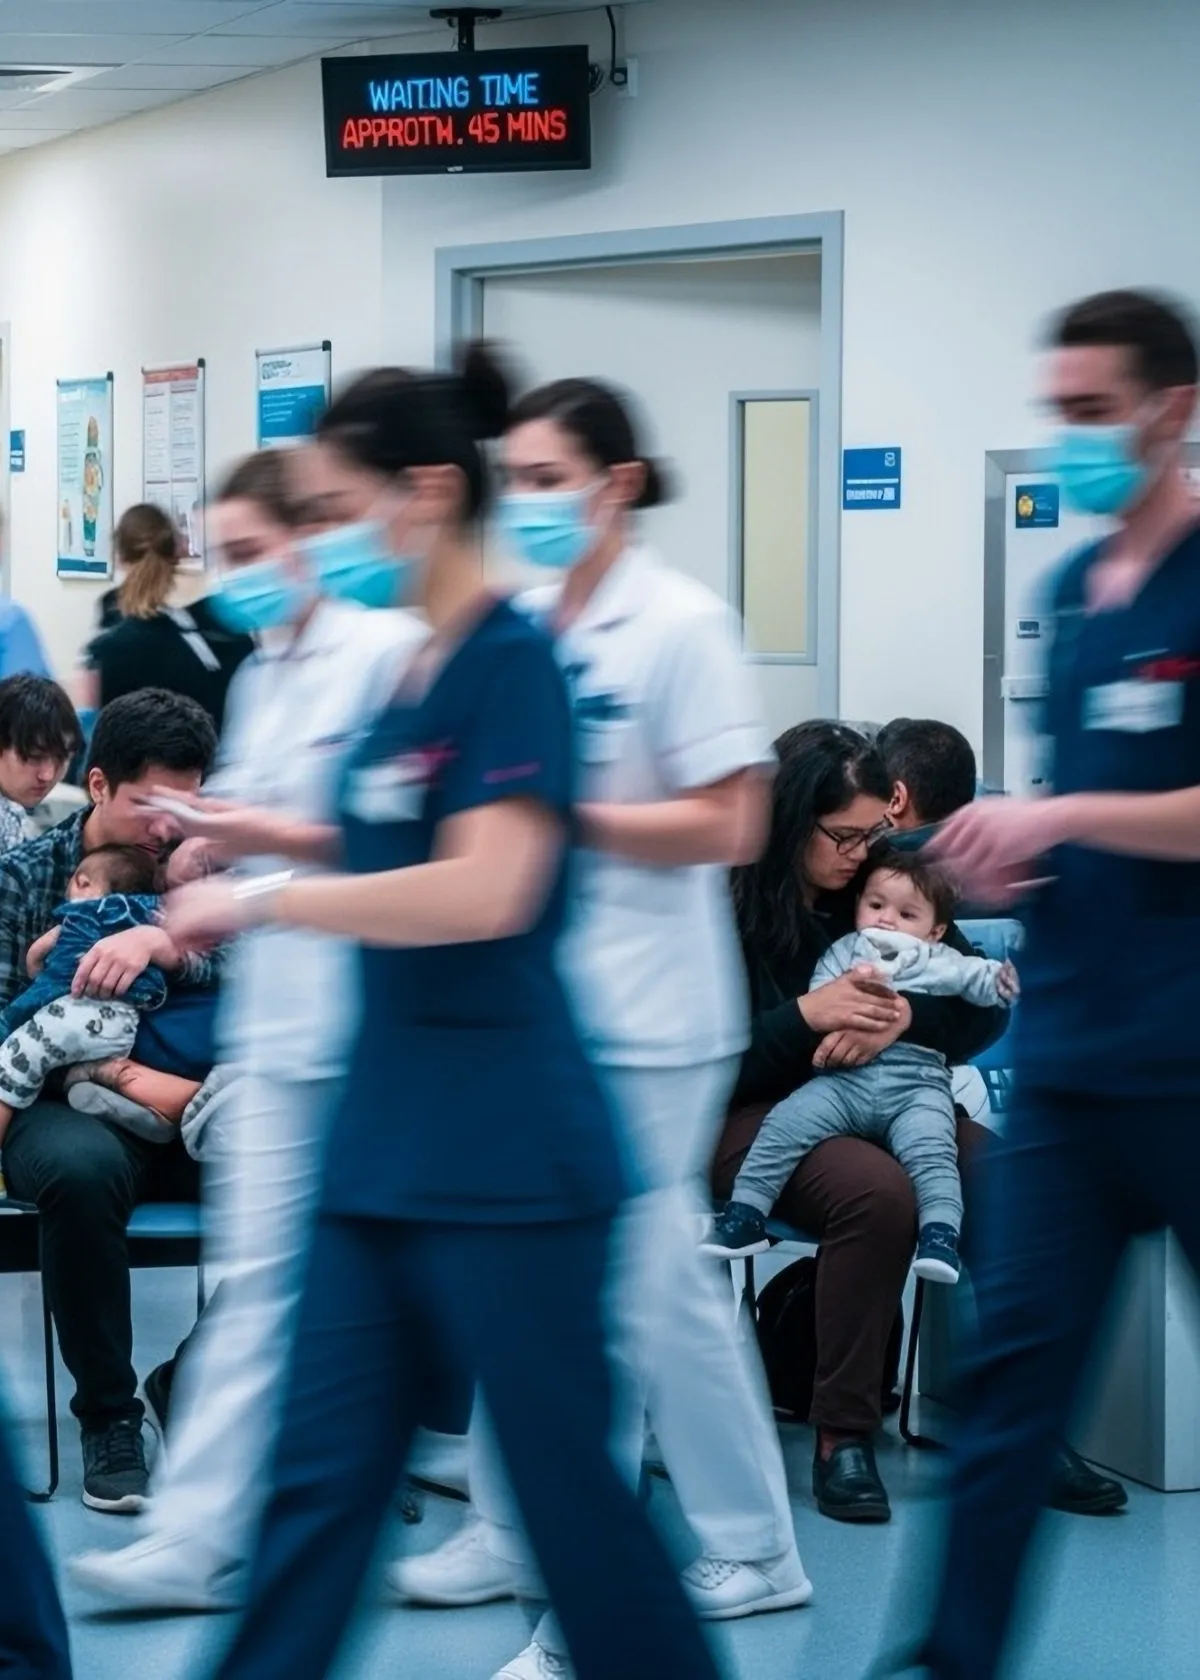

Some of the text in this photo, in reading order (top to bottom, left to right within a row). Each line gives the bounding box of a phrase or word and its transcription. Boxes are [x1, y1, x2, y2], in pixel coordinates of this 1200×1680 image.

[369, 72, 539, 112] WAITING TIME
[468, 112, 500, 144] 45
[507, 110, 567, 142] MINS
